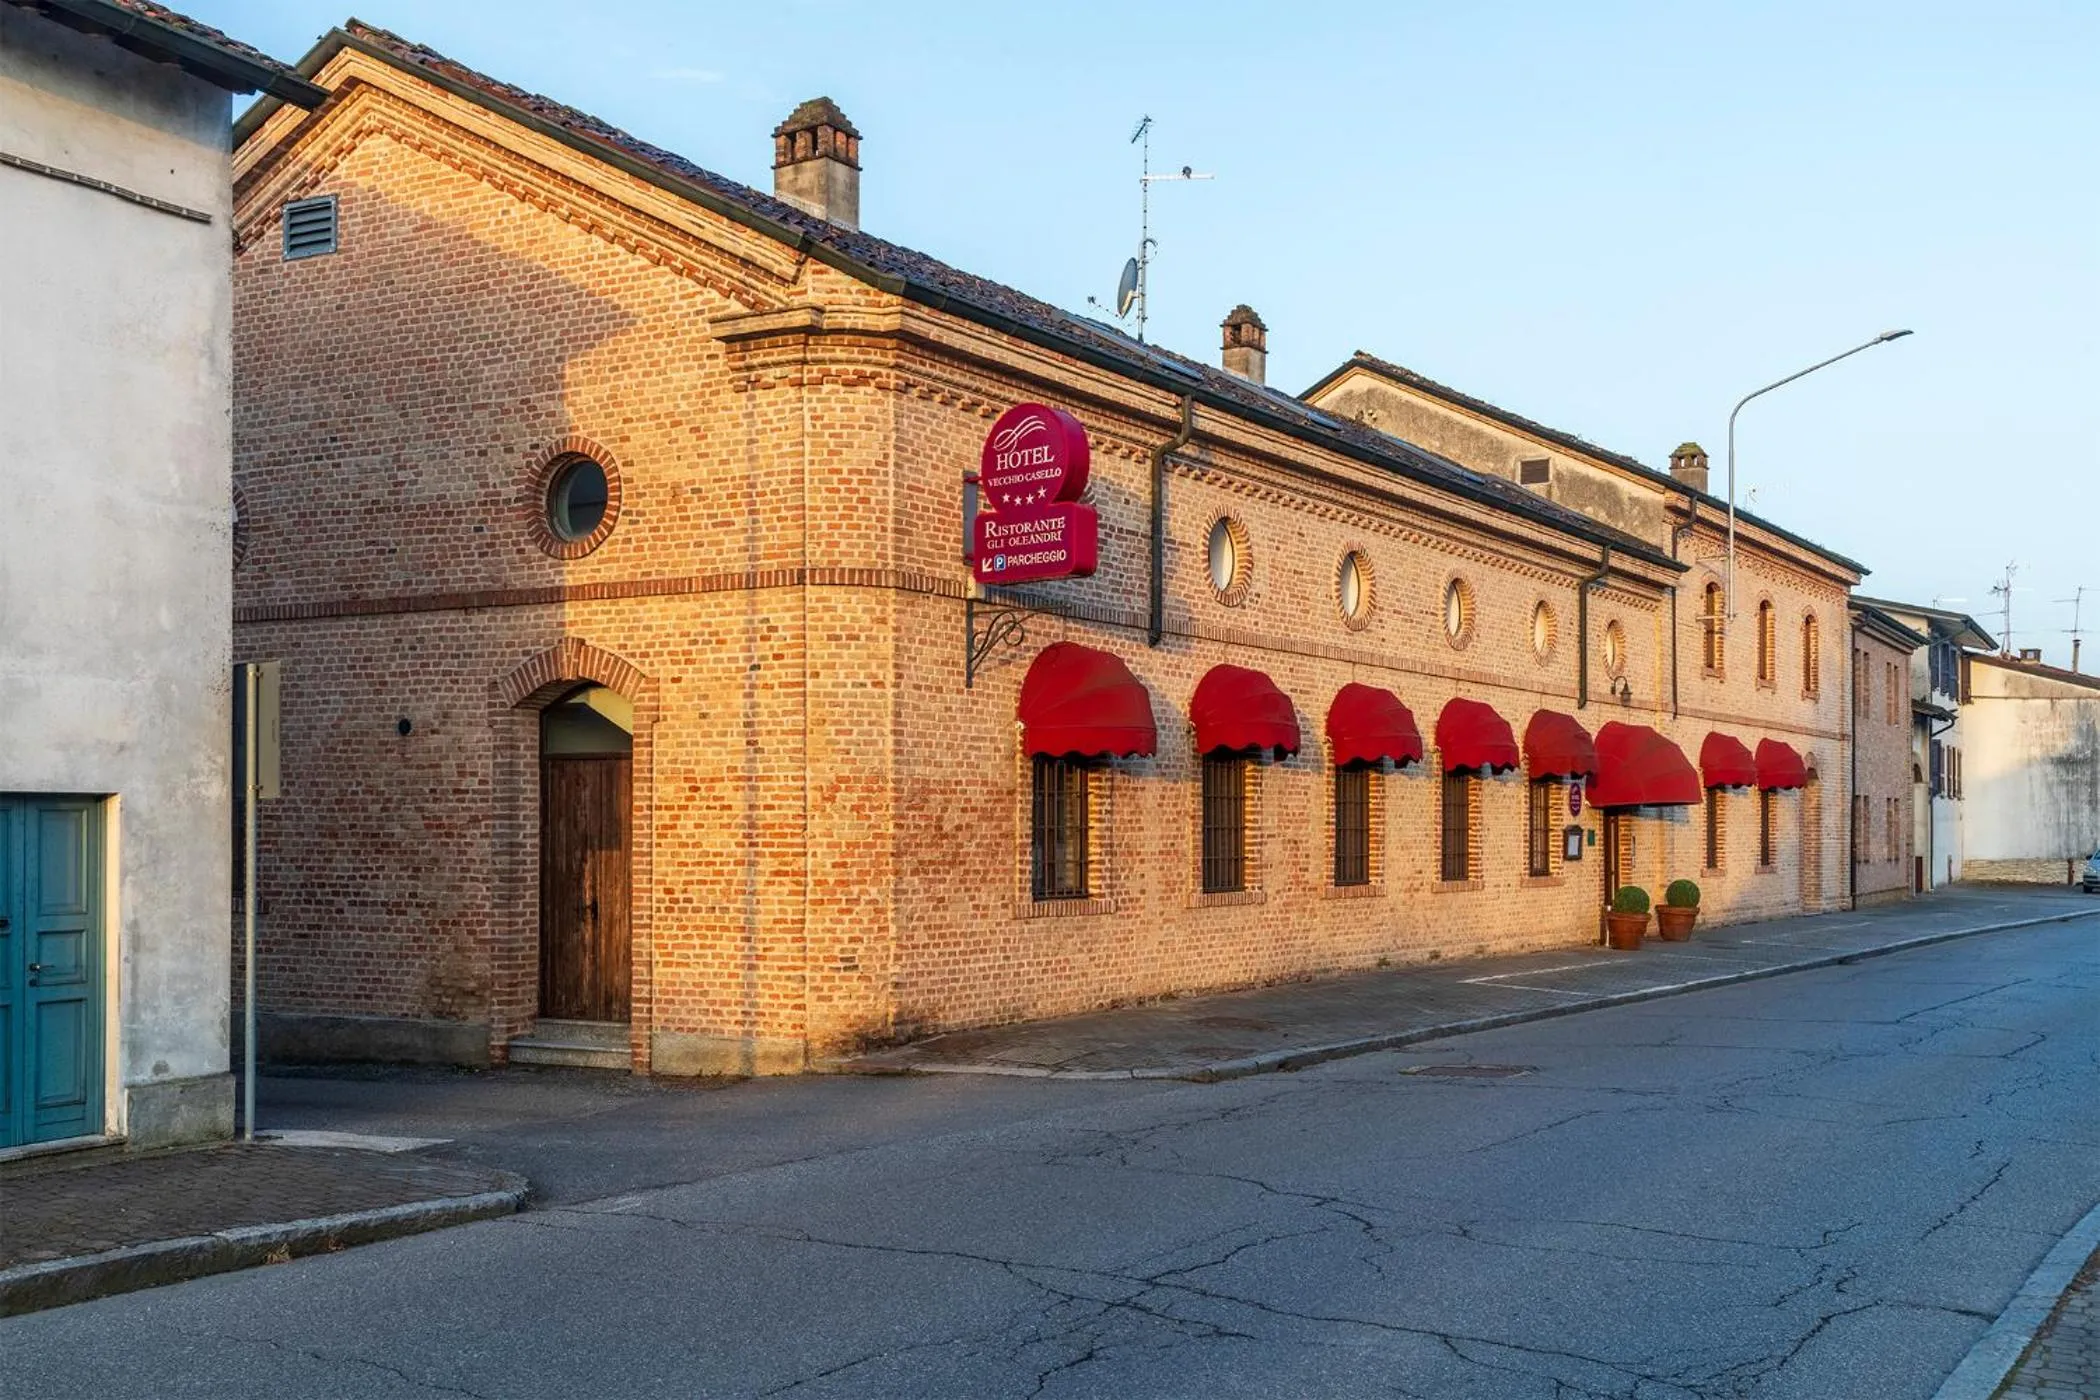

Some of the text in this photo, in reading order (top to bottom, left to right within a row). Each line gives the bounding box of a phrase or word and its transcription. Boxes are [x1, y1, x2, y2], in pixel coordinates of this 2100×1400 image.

[996, 445, 1055, 471] HOTEL
[988, 467, 1062, 487] VECCHIO CASELLO
[987, 530, 1063, 550] GLI OLEANDRI
[1007, 549, 1067, 567] PARCHEGGIO
